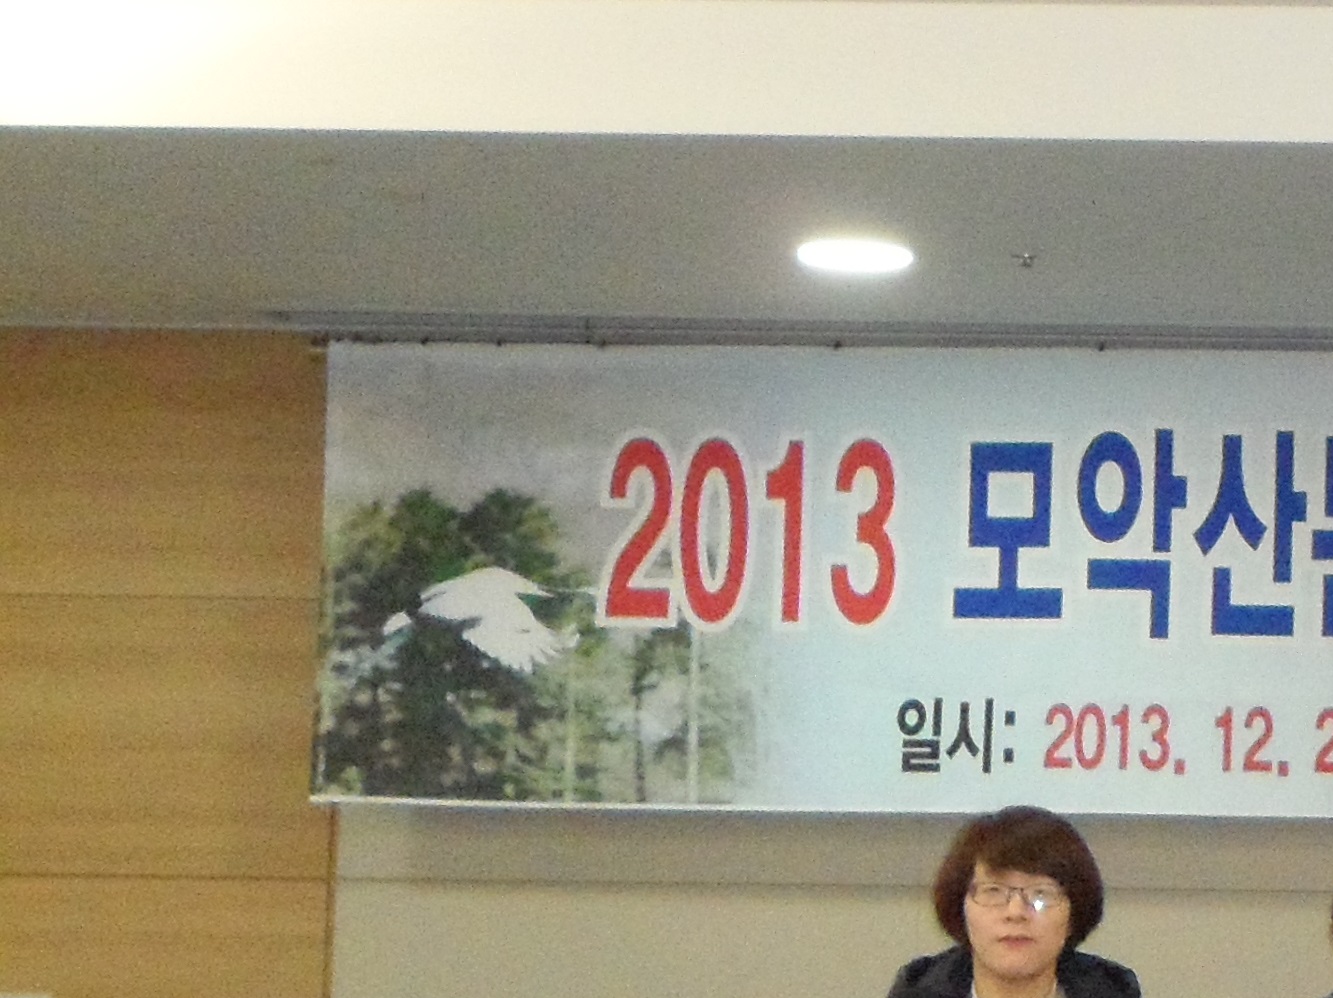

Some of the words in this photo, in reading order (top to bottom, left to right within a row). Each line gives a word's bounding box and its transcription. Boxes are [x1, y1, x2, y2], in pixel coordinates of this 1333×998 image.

[604, 437, 897, 626] 2013
[897, 697, 1015, 774] 일시:
[1043, 702, 1187, 776] 2013.
[1214, 706, 1290, 777] 12.
